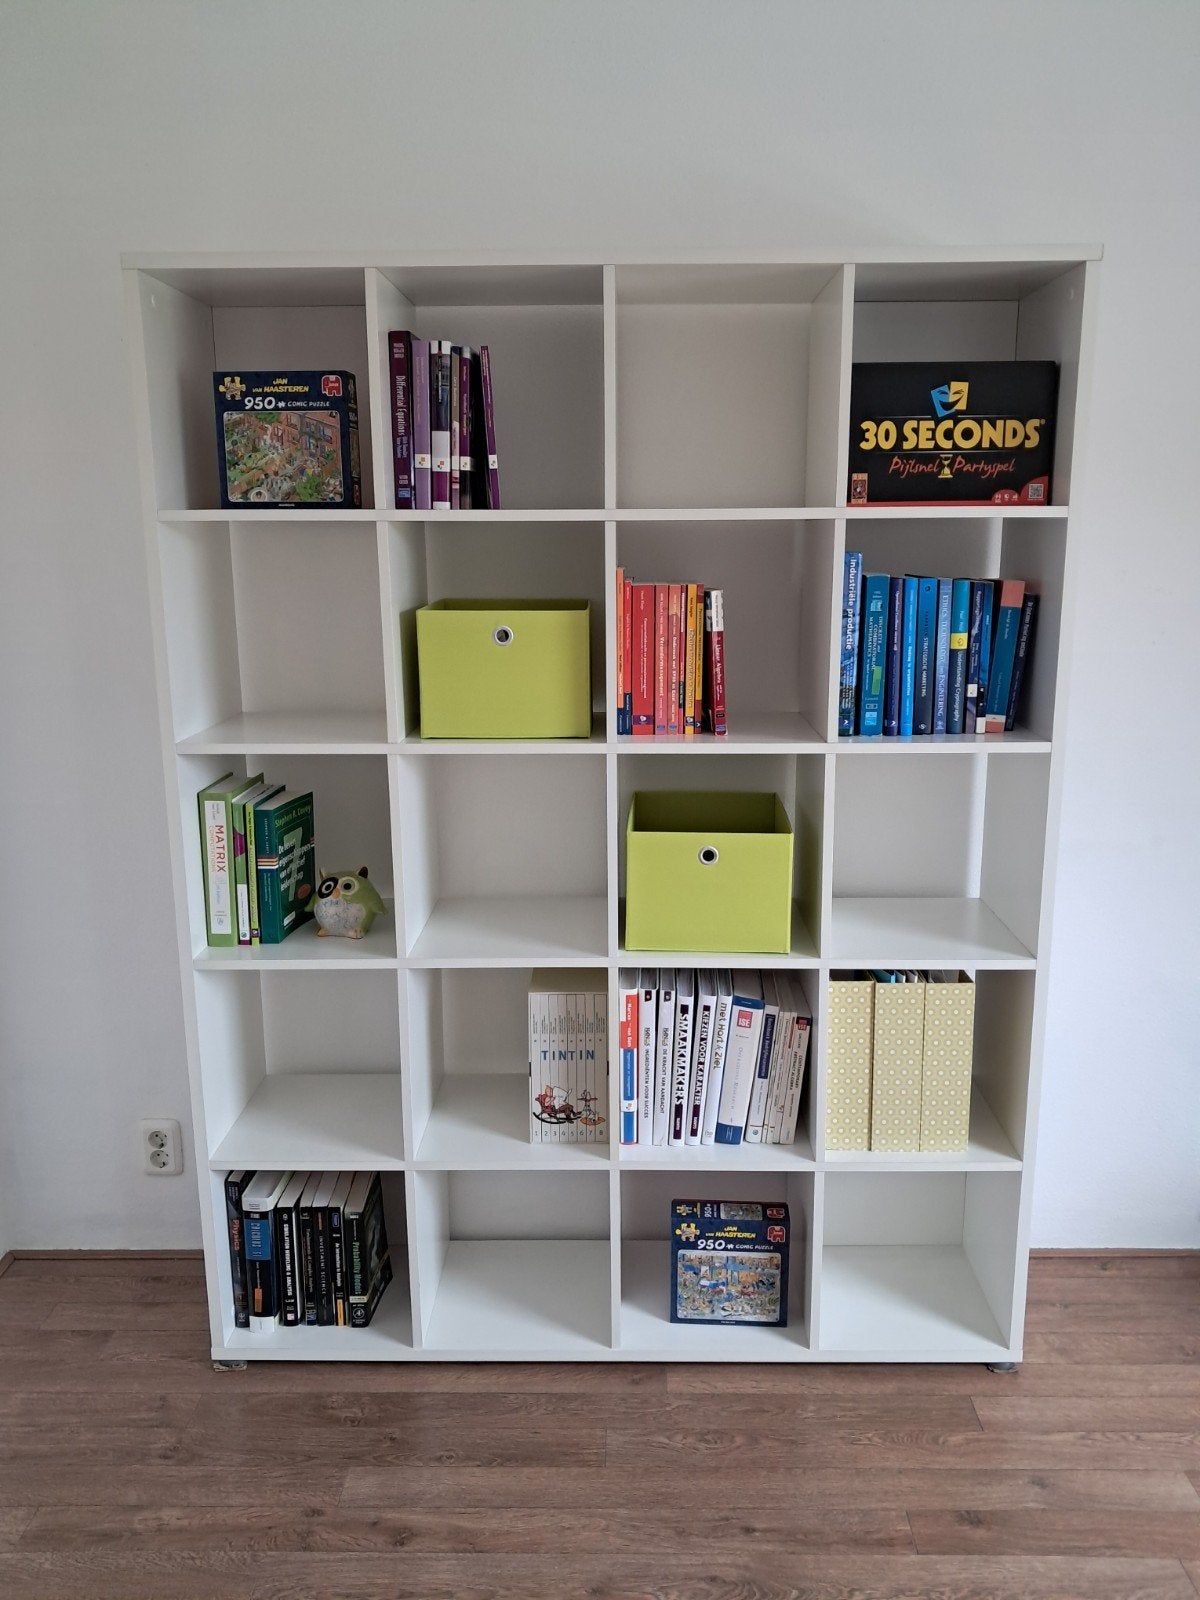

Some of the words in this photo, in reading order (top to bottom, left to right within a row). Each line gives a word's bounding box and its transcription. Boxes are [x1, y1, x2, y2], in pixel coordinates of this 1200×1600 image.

[273, 378, 288, 386] JAN
[396, 375, 406, 406] Differential
[244, 396, 276, 410] 950
[396, 408, 407, 436] Equations
[859, 420, 898, 450] 30
[902, 418, 1040, 450] SECONDS
[889, 455, 940, 479] Pijlsnel
[952, 454, 1016, 478] Partyspel
[848, 559, 857, 606] Industriële
[846, 608, 854, 650] productie
[955, 652, 964, 687] Understanding
[954, 688, 962, 722] Cryptography
[215, 825, 226, 872] MATRIX
[700, 1011, 710, 1038] KIEZEN
[719, 1002, 727, 1021] met
[738, 1018, 750, 1028] ISE
[541, 1050, 595, 1061] TINTIN
[675, 1014, 688, 1105] SMAAKMAKERS
[698, 1040, 707, 1063] VOOR
[694, 1064, 704, 1105] KARAKTER
[697, 1239, 726, 1250] 950
